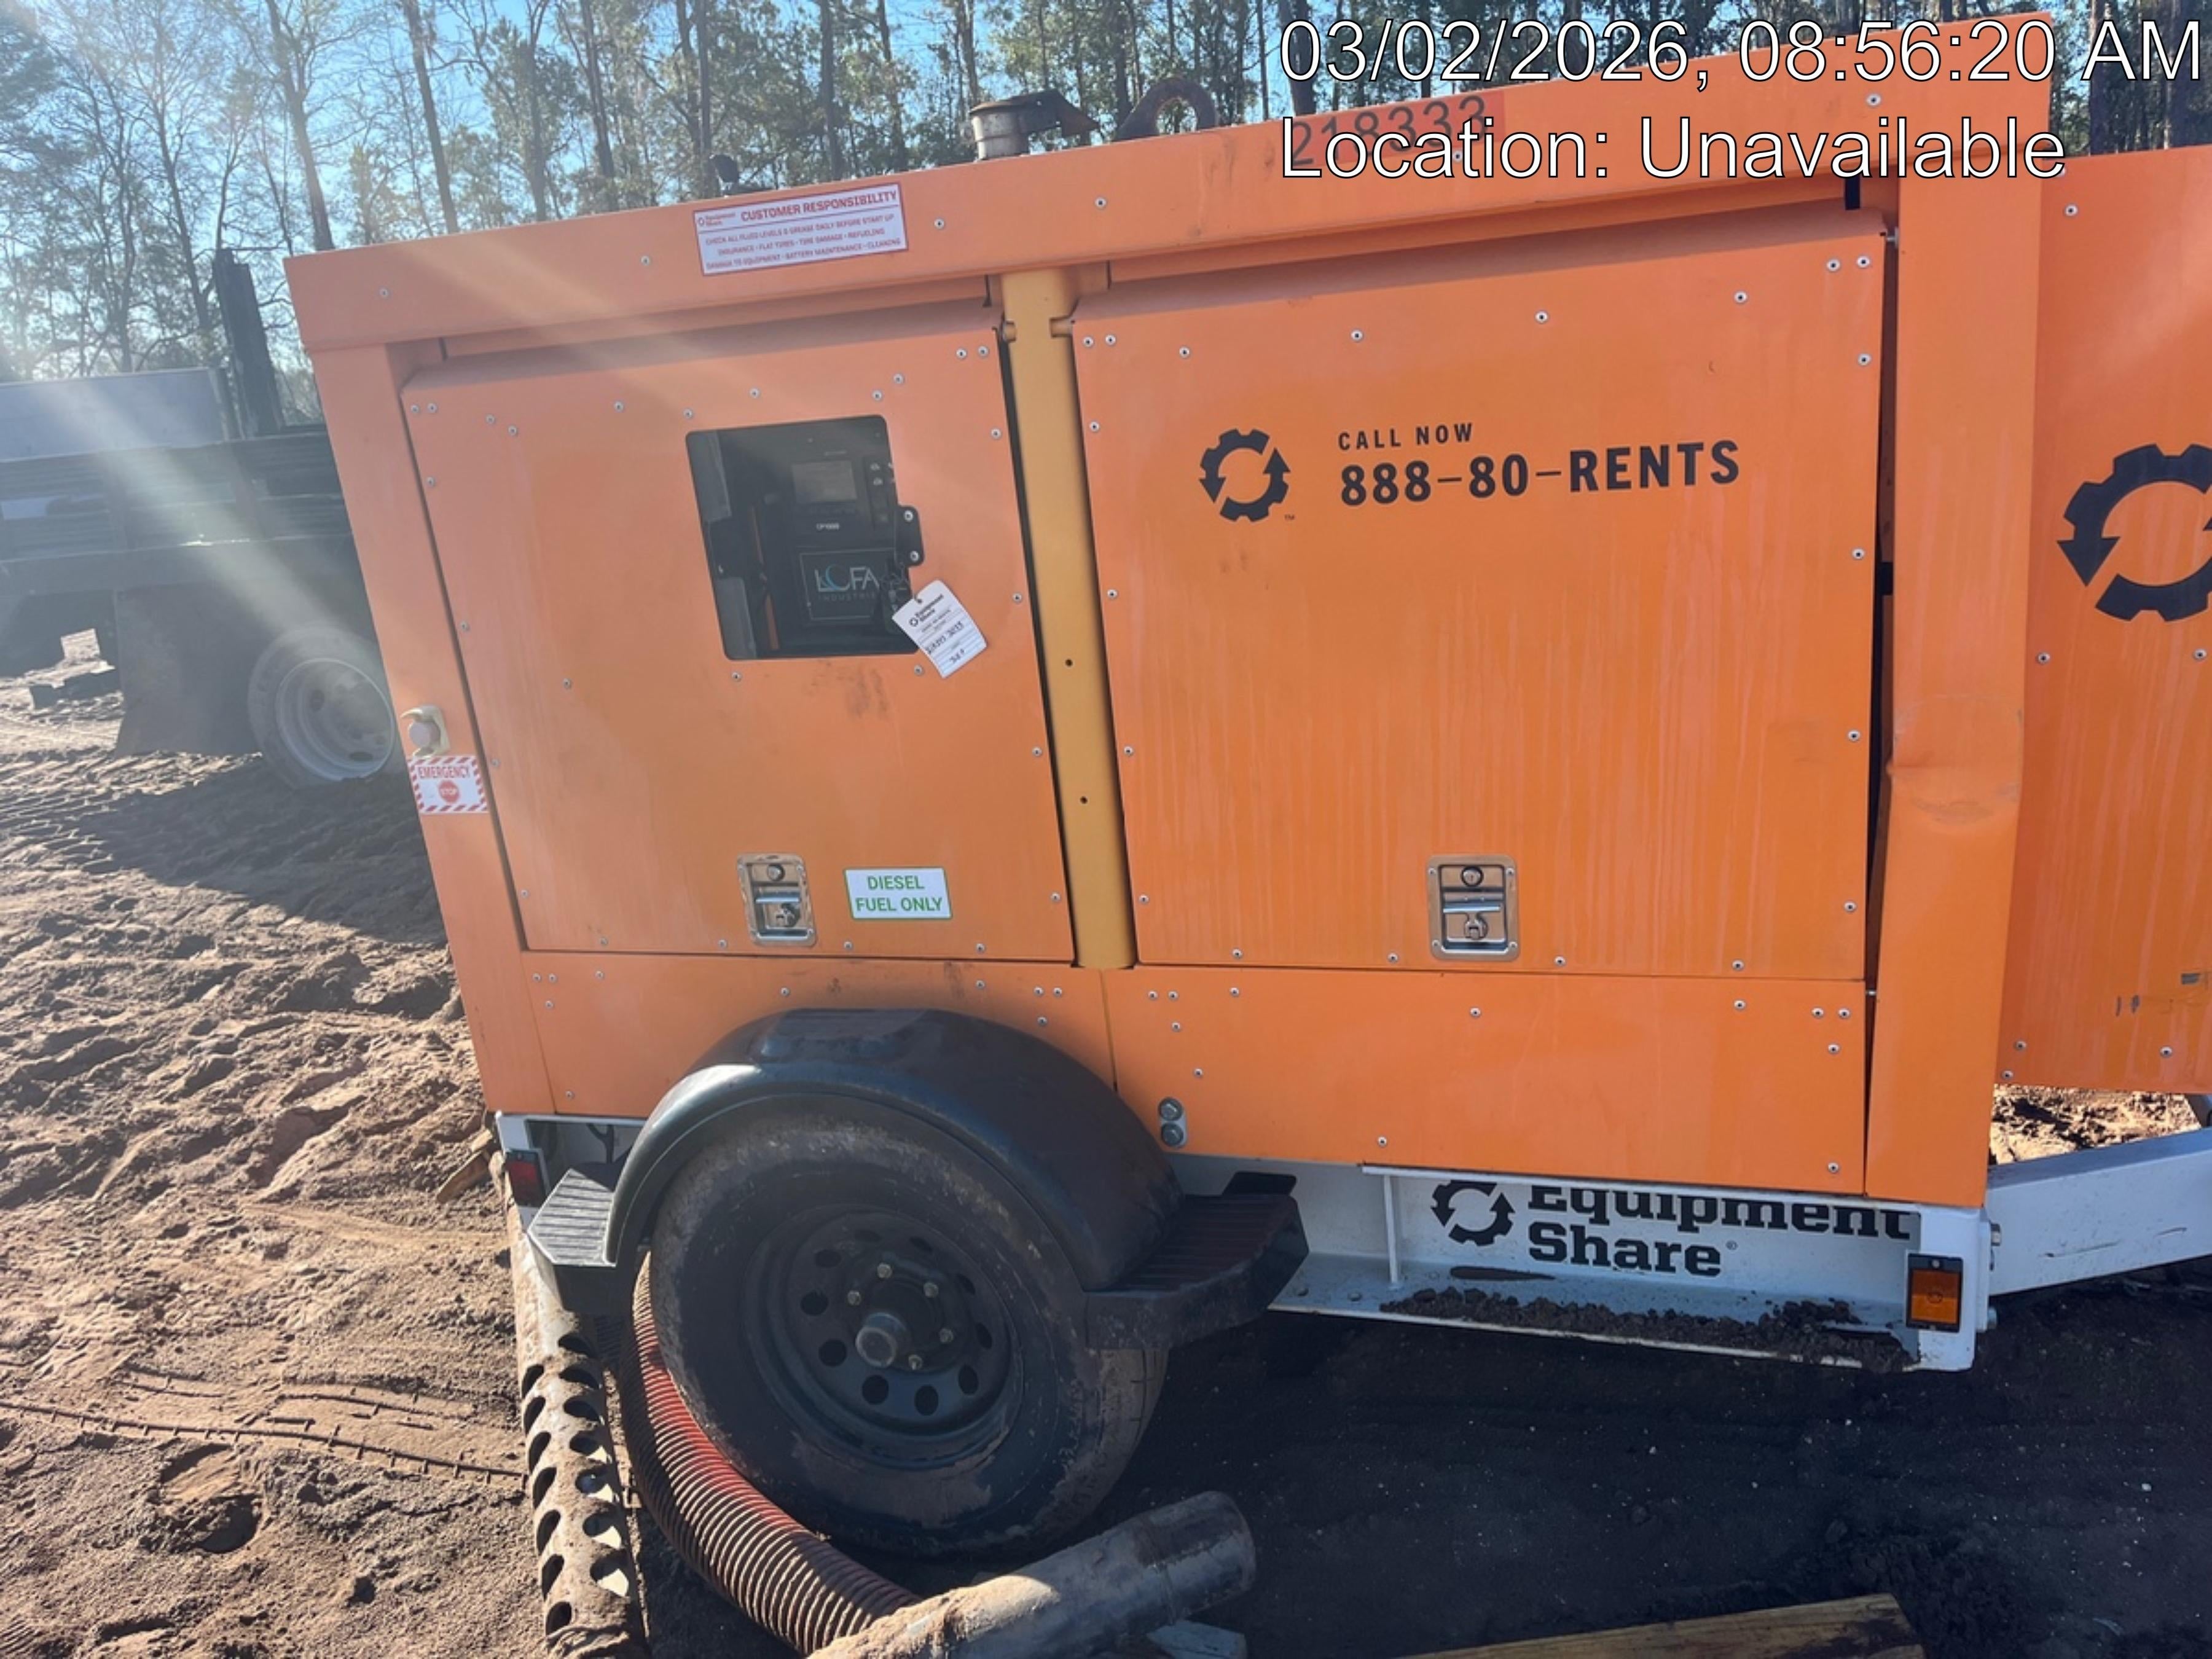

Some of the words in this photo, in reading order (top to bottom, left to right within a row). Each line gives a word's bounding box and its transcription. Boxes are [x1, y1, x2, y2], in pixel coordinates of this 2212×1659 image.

[1292, 95, 1488, 165] 218333
[741, 204, 800, 222] CUSTOMER
[803, 190, 896, 213] RESPONSIBILITY
[1338, 430, 1402, 451] CALL
[1416, 423, 1473, 445] NOW
[1341, 439, 1740, 507] 888-80-RENTS
[815, 564, 880, 592] LOFA
[419, 766, 470, 779] EMERGENCY
[867, 875, 925, 890] DIESEL
[855, 897, 896, 912] FUEL
[901, 896, 943, 912] ONLY
[1528, 1185, 1923, 1241] Equipment
